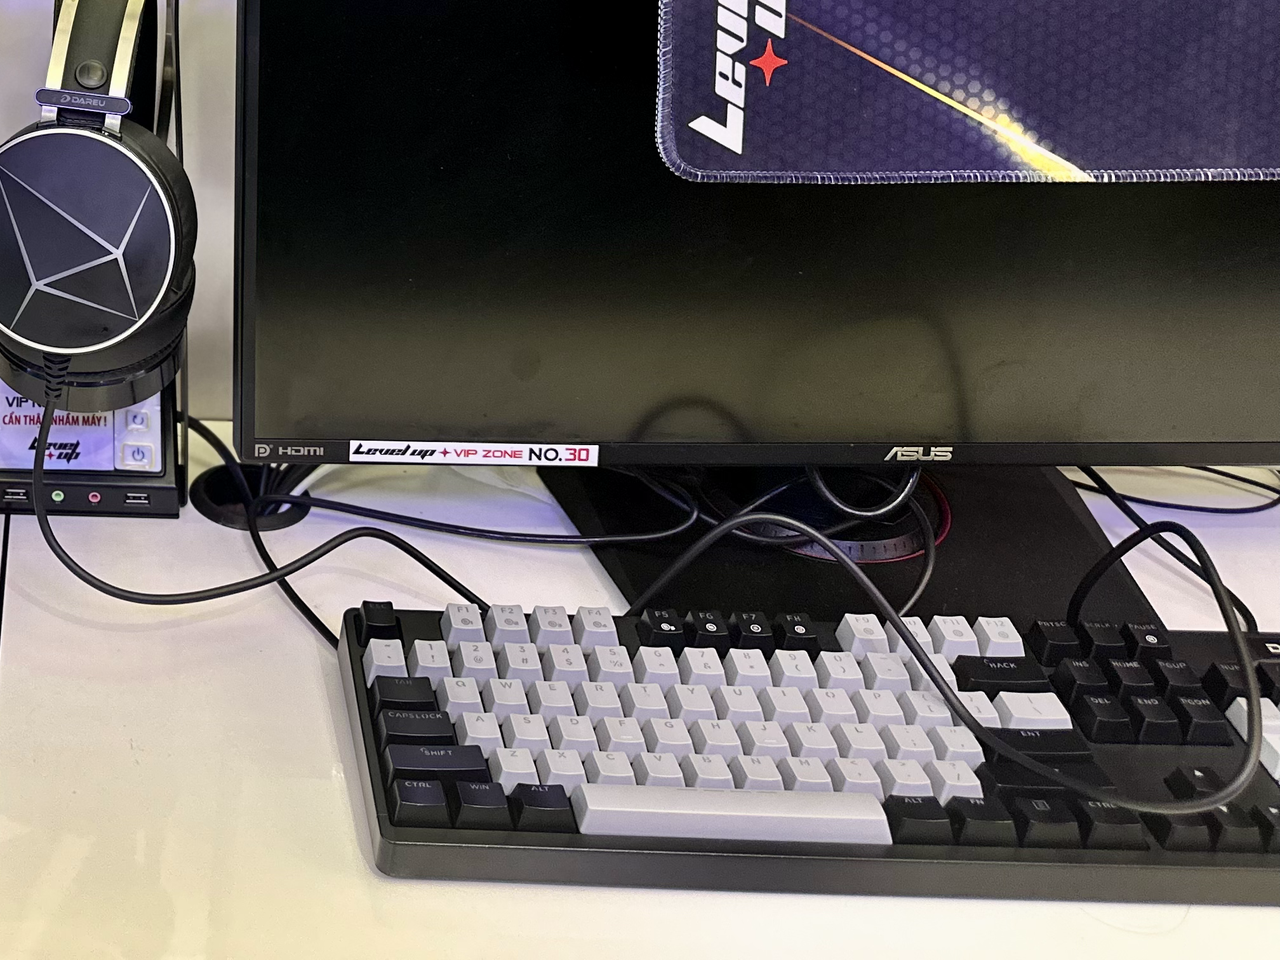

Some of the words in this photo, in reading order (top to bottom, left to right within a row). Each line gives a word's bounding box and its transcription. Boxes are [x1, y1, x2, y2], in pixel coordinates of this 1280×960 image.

[71, 96, 106, 107] DAREU
[5, 396, 28, 408] VIP
[81, 413, 102, 427] MÁY
[278, 446, 324, 456] HDMI
[352, 443, 412, 455] Level
[409, 449, 437, 460] up
[482, 449, 523, 458] ZONE
[528, 447, 562, 461] NO.
[564, 448, 590, 462] 30
[884, 446, 953, 461] ASUS
